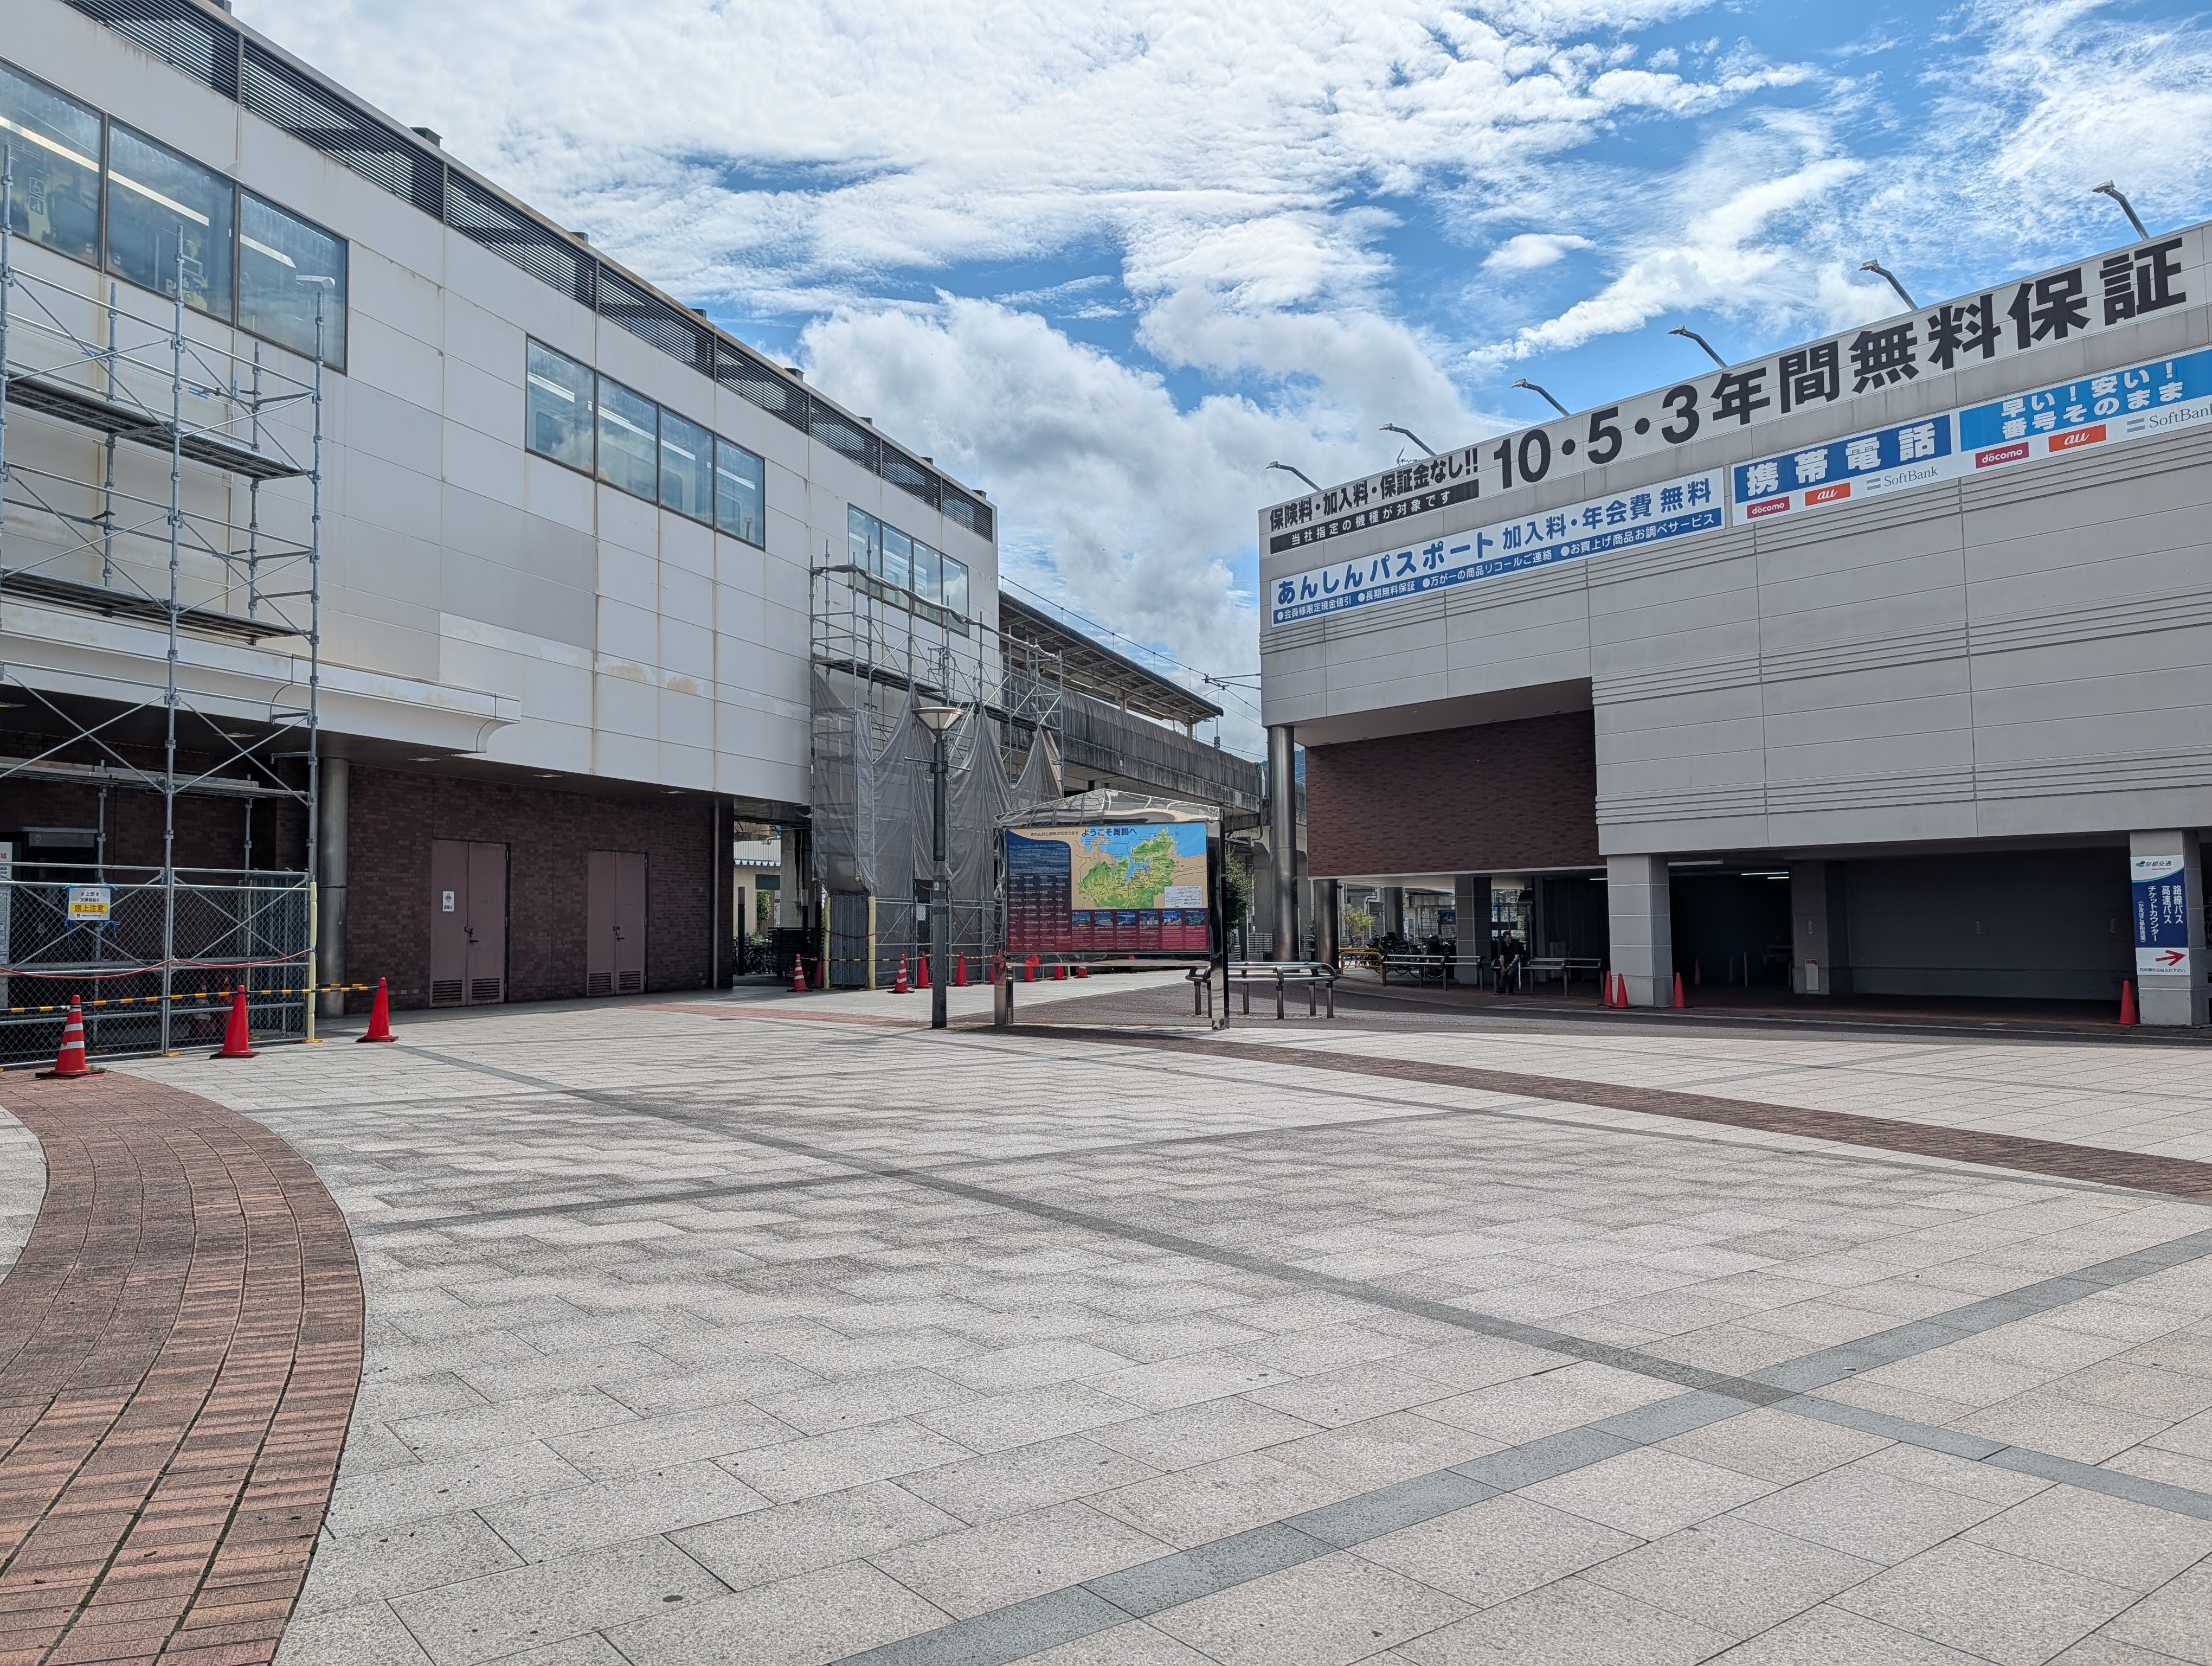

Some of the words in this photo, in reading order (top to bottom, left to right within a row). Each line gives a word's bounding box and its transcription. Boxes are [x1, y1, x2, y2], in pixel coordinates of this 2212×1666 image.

[2002, 381, 2183, 439] 番号そのまま
[2064, 432, 2090, 445] au
[1747, 422, 1935, 496] 携帯電話
[1982, 449, 2023, 463] docomo
[1884, 466, 1938, 487] SoftBank
[1752, 502, 1785, 515] docomo
[1817, 488, 1837, 500] au
[1292, 490, 1451, 546] 当社指定の機種が対象です
[1278, 531, 1494, 605] あんしんパスポート
[1081, 828, 1137, 837] ようこそ舞鶴へ
[74, 904, 104, 912] 頭上注意
[2148, 886, 2159, 941] チケットカウンター
[2162, 885, 2172, 924] 高速バス
[2173, 885, 2184, 924] 路線バス
